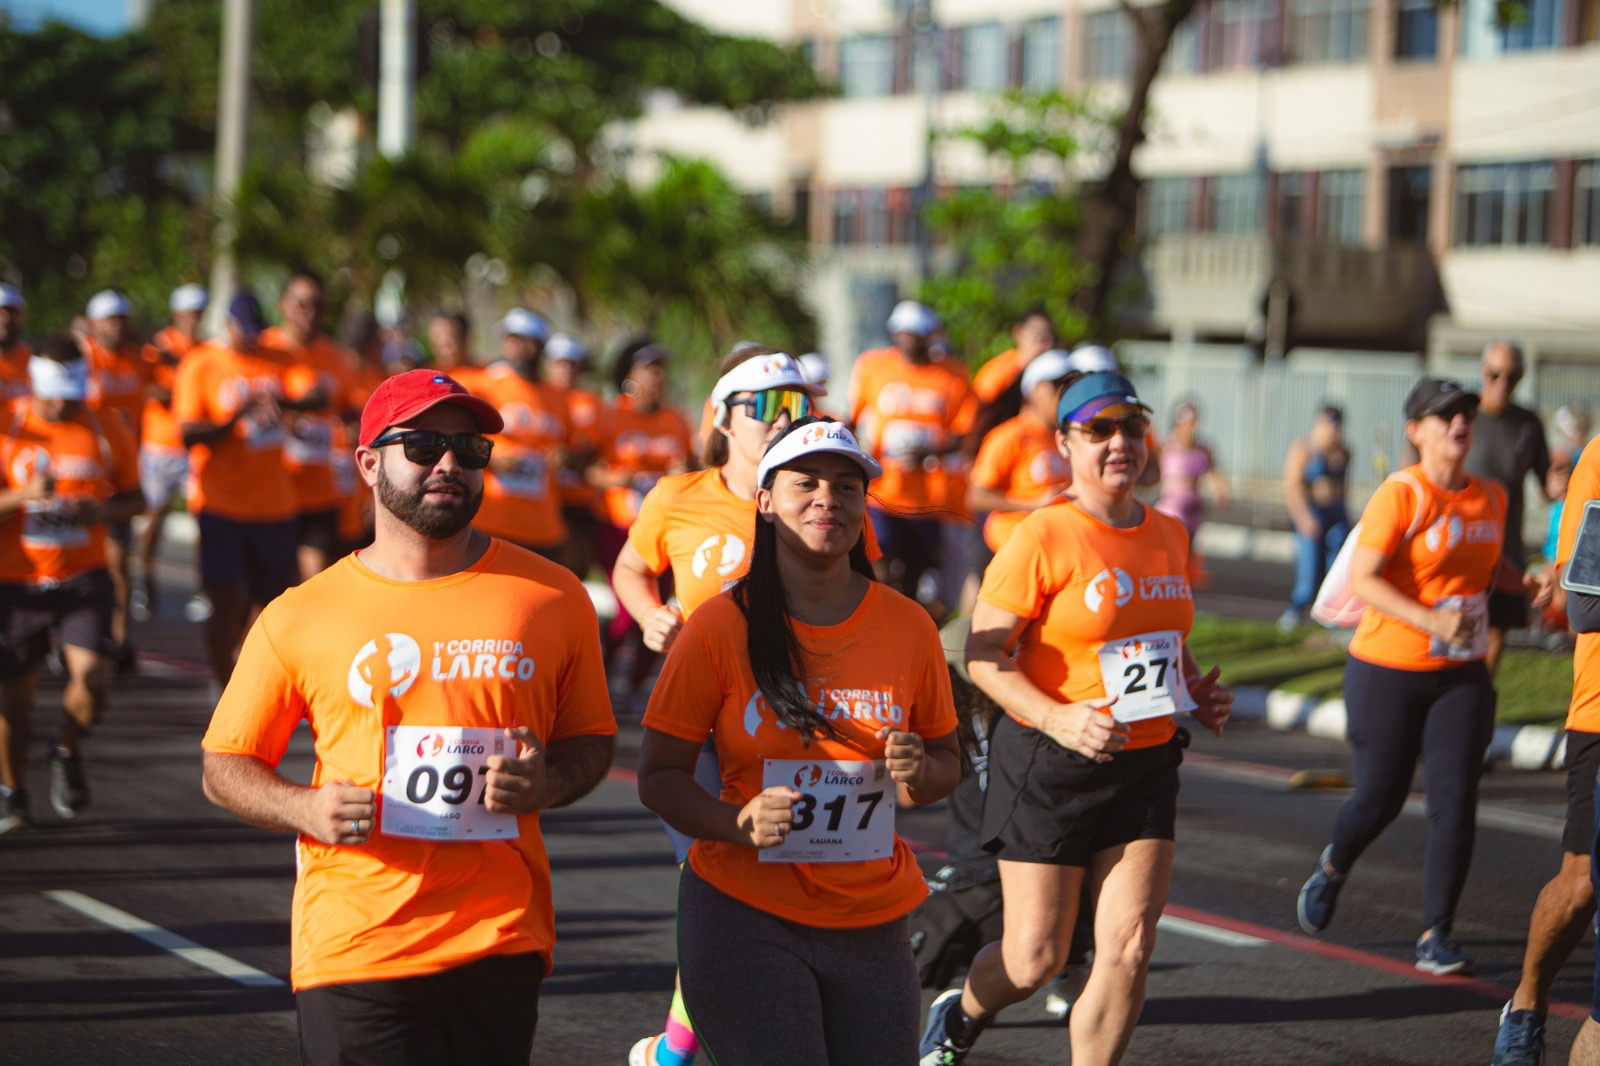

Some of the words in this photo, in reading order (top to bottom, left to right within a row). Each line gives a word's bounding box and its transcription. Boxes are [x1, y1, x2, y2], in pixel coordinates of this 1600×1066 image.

[447, 639, 524, 655] CORRIDA
[432, 654, 535, 680] LARCO
[831, 688, 891, 703] CORRIDA
[816, 700, 903, 724] LARCO
[447, 745, 485, 755] LARCO
[824, 775, 864, 785] LARCO
[440, 812, 461, 820] IAGO
[791, 790, 884, 831] 317
